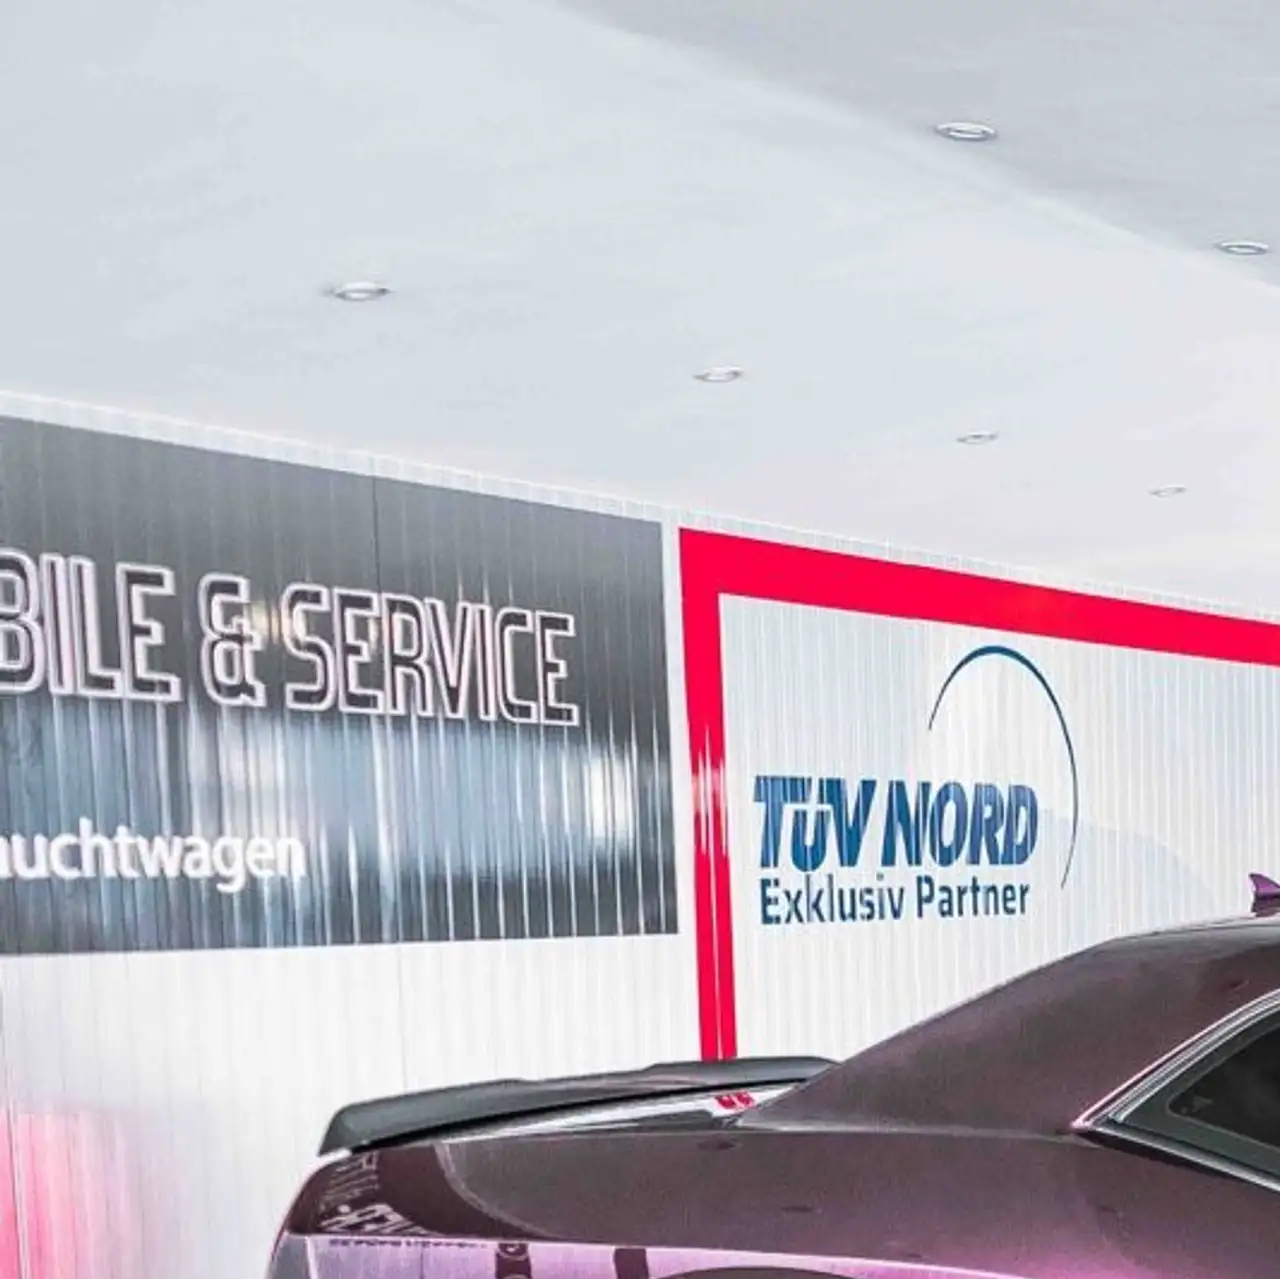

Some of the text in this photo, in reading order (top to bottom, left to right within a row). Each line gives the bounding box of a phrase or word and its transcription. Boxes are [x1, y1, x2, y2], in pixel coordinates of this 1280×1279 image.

[199, 572, 267, 707] &
[281, 581, 580, 727] SERVICE
[753, 775, 1039, 872] TÜV NORD
[760, 873, 1030, 925] Exklusiv Partner
